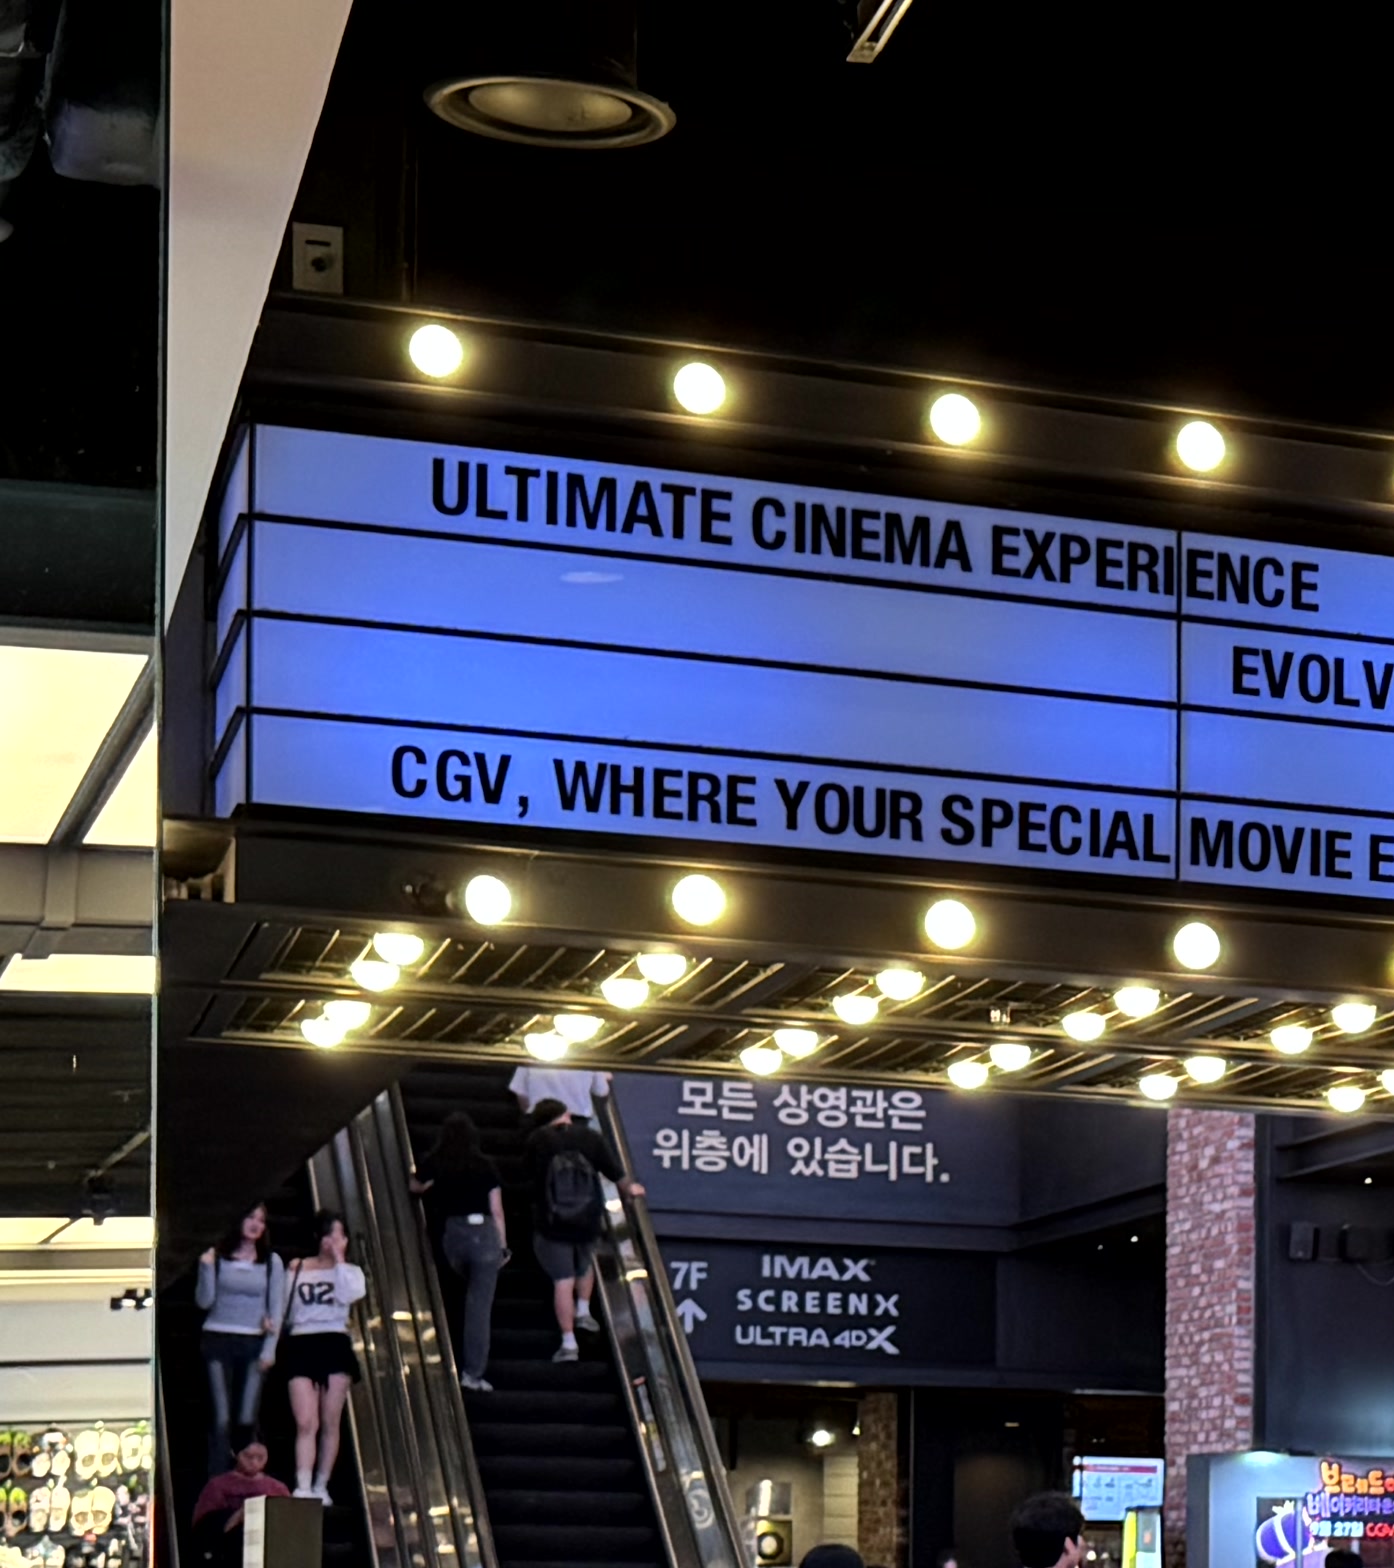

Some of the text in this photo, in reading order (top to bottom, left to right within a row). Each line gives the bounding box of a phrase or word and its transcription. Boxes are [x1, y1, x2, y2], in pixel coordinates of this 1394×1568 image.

[430, 456, 1320, 613] ULTIMATE CINEMA EXPERIENCE
[391, 744, 531, 818] CGV,
[553, 758, 758, 827] WHERE
[774, 779, 923, 842] YOUR
[939, 794, 1171, 865] SPECIAL
[1189, 817, 1354, 876] MOVIE
[677, 1080, 927, 1131] 모든 상영관은
[653, 1128, 950, 1183] 위층에 있습니다.
[670, 1261, 708, 1291] 7F
[761, 1254, 872, 1281] IMAX
[298, 1282, 334, 1305] 02
[736, 1288, 900, 1317] SCREENX
[735, 1324, 900, 1355] ULTRA 4DX
